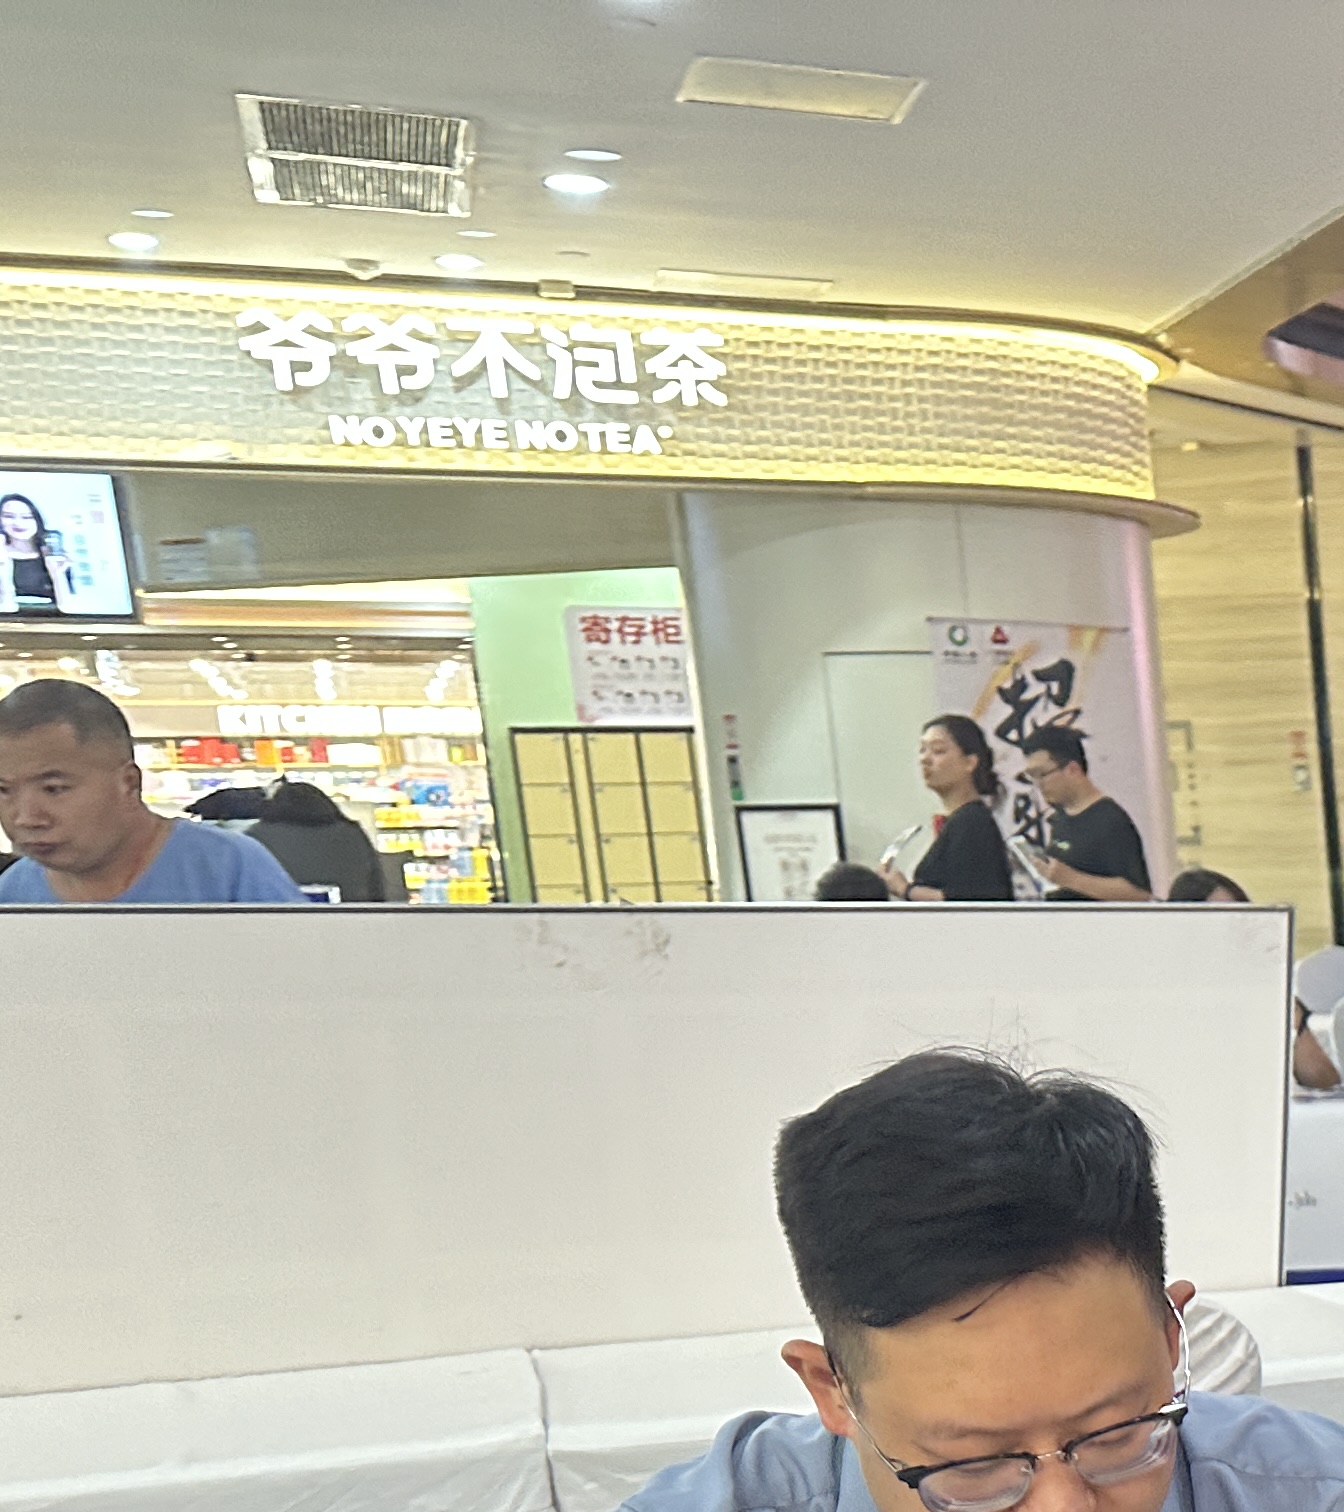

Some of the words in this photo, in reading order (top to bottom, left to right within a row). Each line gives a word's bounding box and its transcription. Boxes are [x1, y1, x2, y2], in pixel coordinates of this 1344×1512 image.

[235, 308, 728, 407] 爷爷不泡茶
[579, 614, 685, 646] 寄存柜
